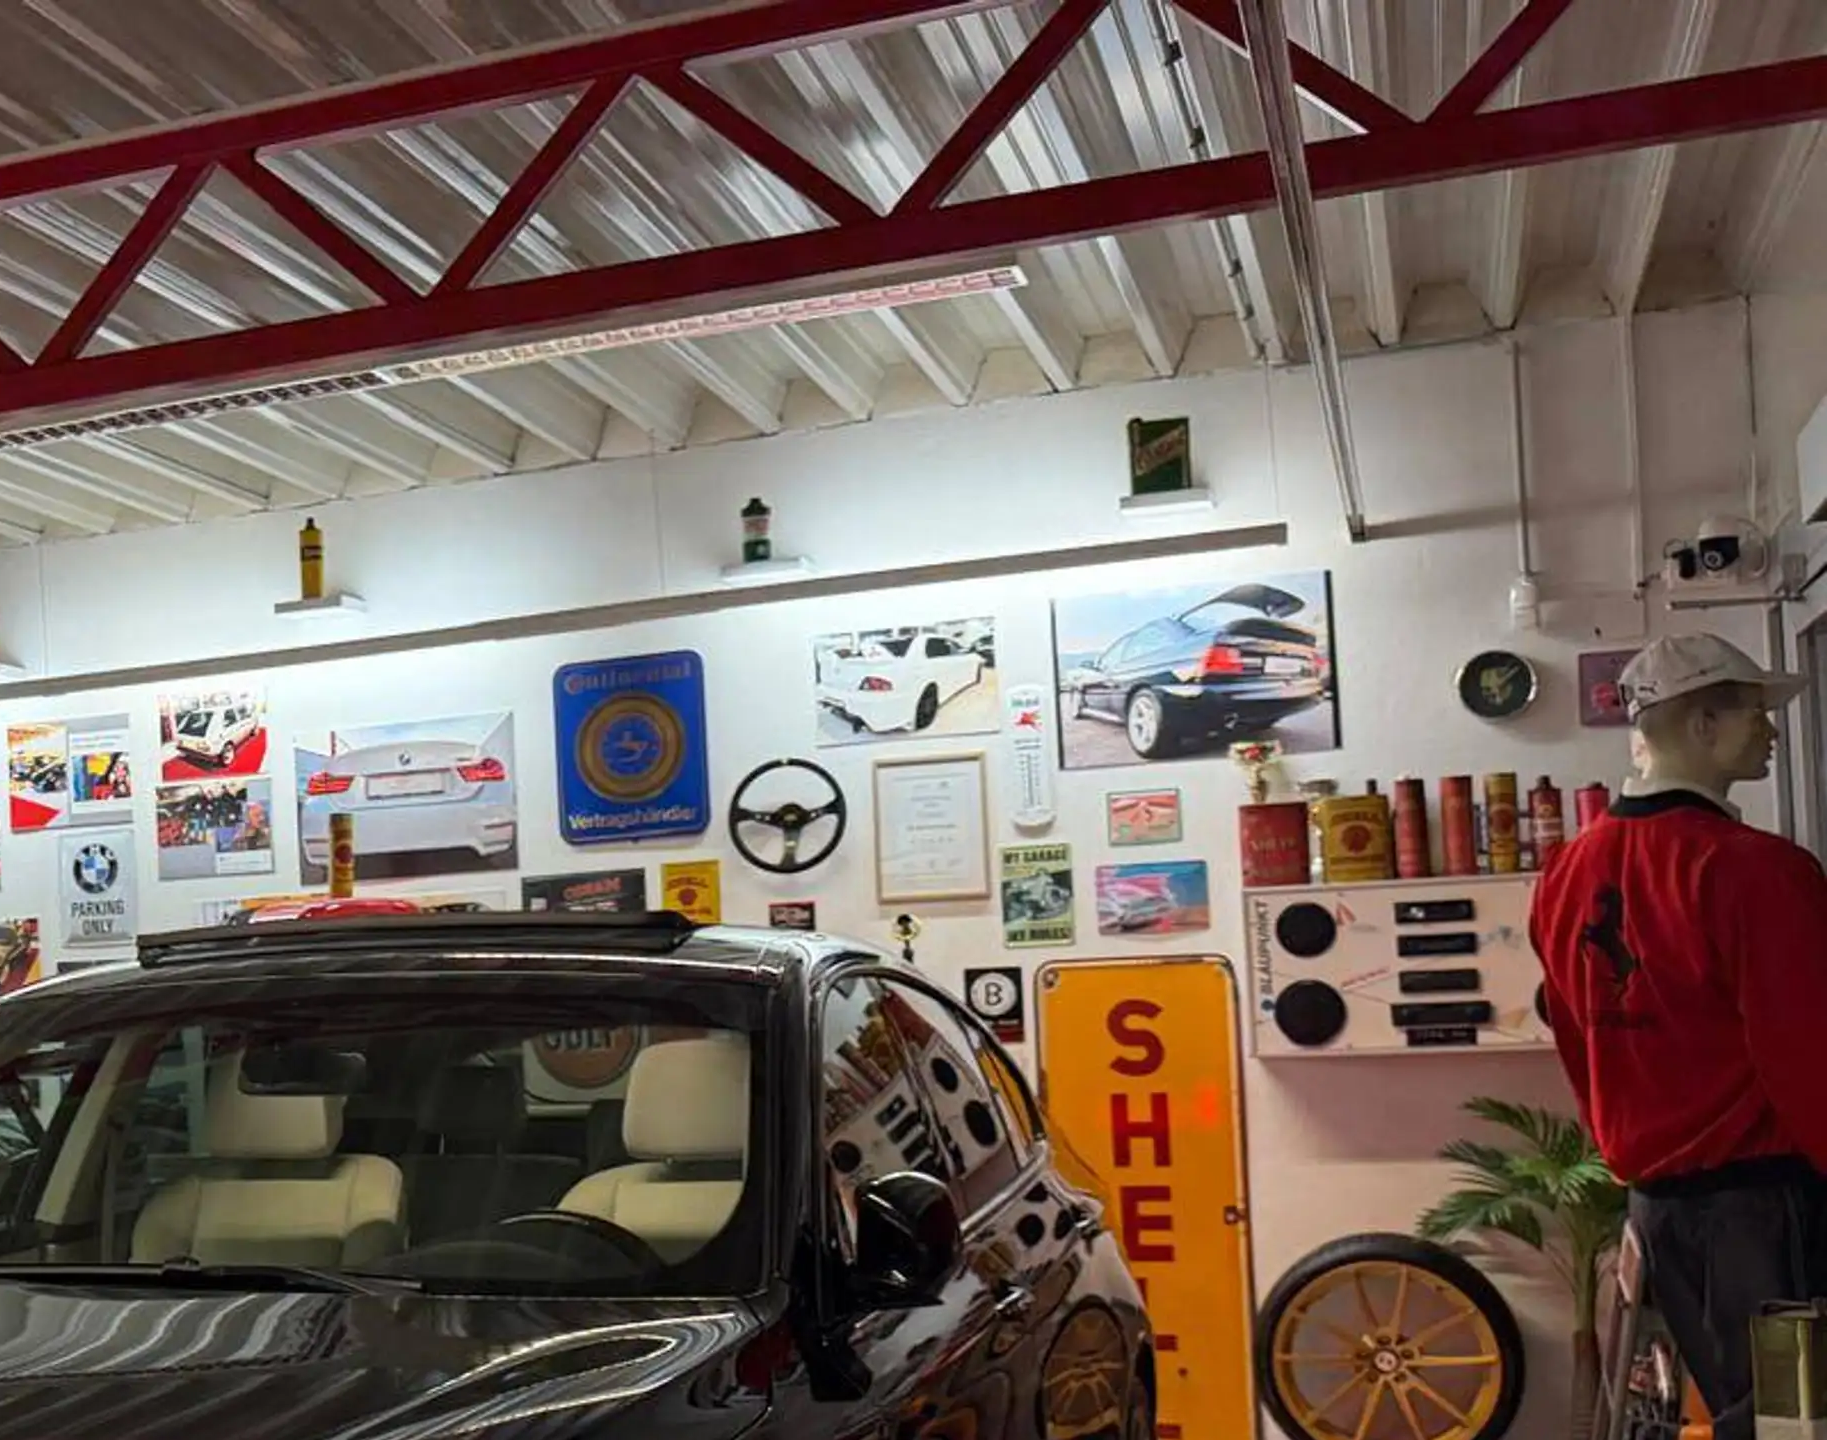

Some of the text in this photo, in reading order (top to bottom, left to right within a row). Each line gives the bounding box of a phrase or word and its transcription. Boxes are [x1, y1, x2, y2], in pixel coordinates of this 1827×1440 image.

[71, 899, 126, 919] PARKING
[82, 919, 115, 936] ONLY
[1255, 900, 1274, 995] BLAUPUNKT
[984, 982, 1004, 1006] B
[1105, 999, 1183, 1440] SHE
